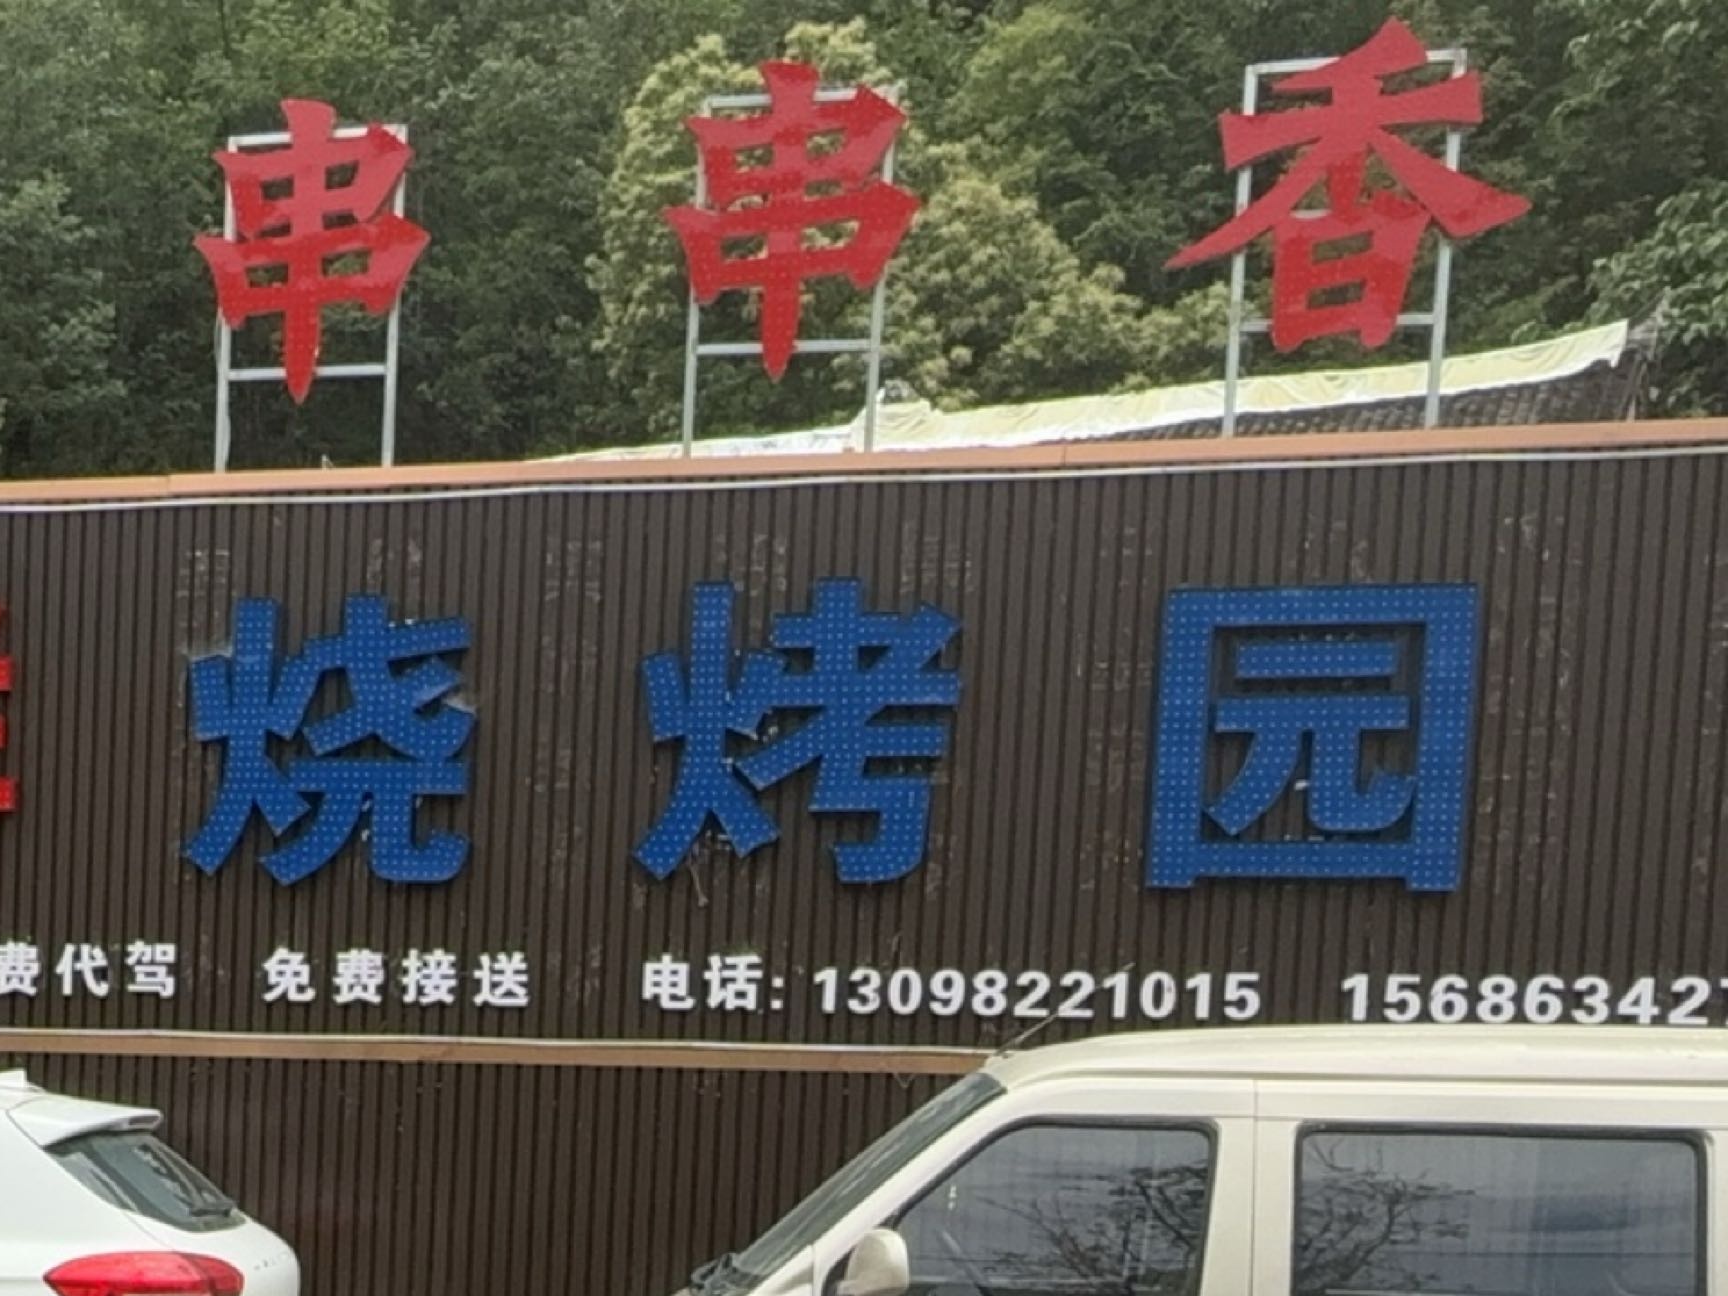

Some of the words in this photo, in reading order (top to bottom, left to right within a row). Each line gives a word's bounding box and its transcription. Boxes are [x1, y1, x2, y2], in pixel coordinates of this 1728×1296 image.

[262, 946, 530, 1006] 免费接送
[1340, 972, 1728, 1025] 15686342
